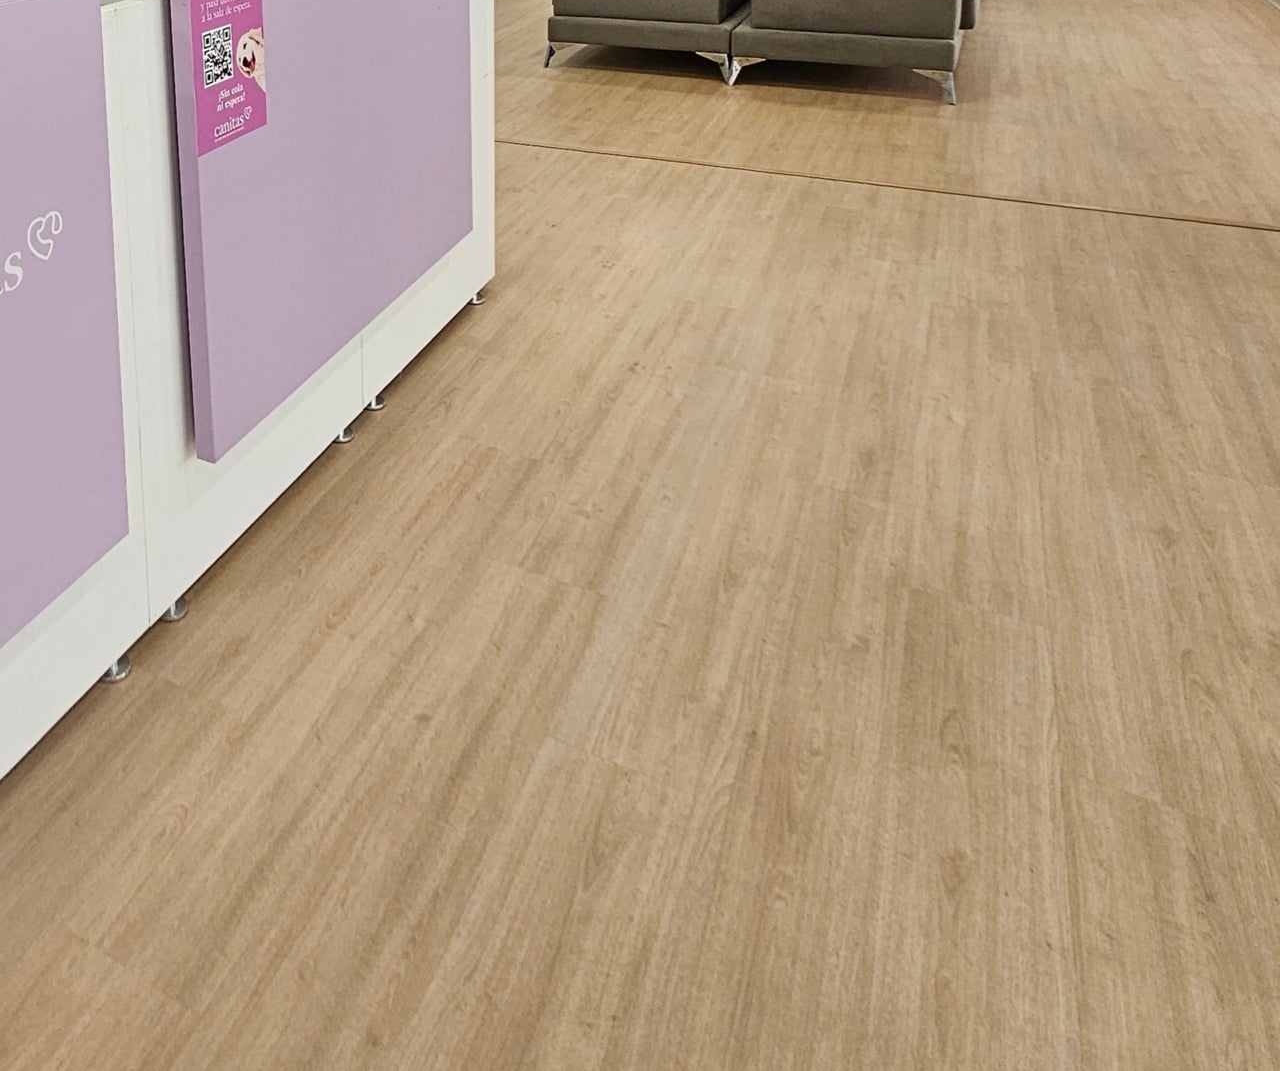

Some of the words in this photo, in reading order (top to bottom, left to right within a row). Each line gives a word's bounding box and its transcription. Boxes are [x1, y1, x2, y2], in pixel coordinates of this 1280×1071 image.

[206, 0, 219, 12] pasa
[206, 11, 213, 22] la
[213, 7, 225, 19] sala
[225, 4, 232, 15] de
[231, 83, 244, 95] cola
[217, 101, 224, 112] ni
[224, 91, 246, 109] espera!
[214, 114, 245, 138] canitas
